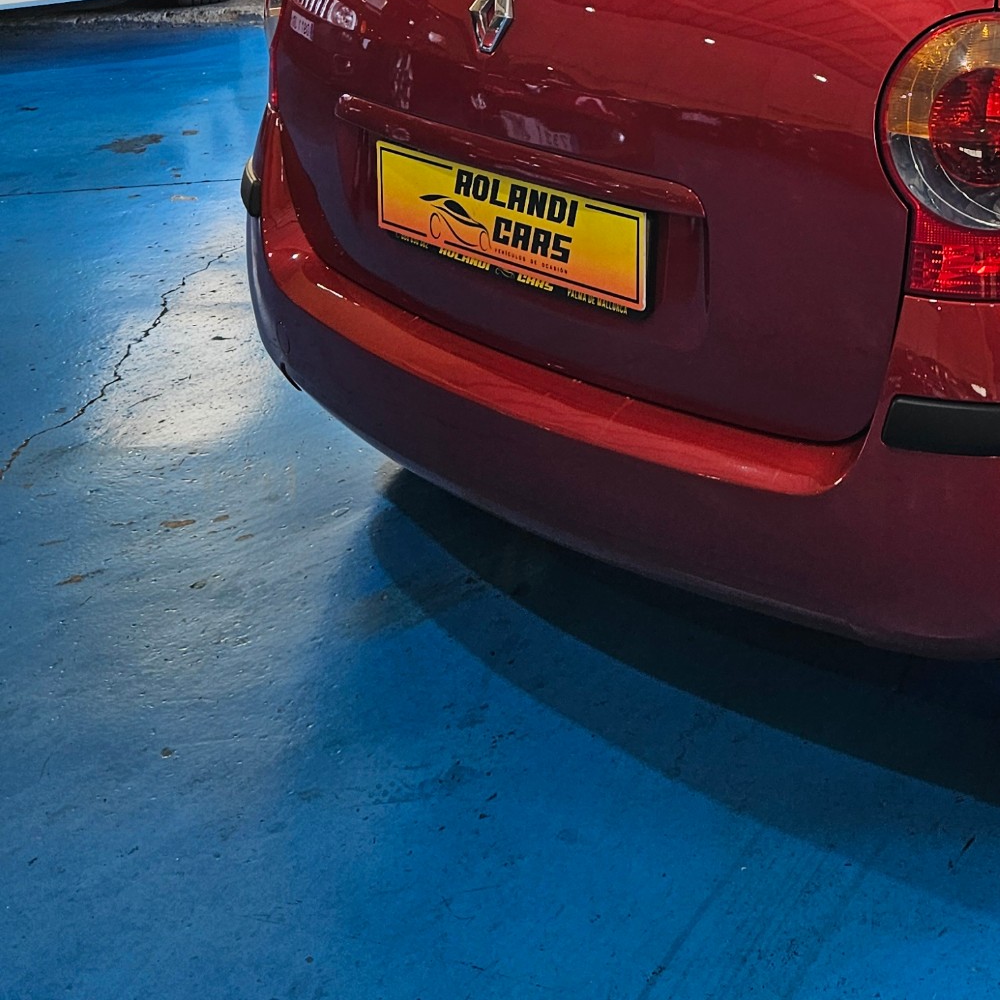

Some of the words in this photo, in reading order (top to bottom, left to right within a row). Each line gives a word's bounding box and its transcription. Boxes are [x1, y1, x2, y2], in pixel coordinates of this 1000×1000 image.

[455, 170, 579, 227] ROLANDI
[491, 216, 573, 264] CARS
[516, 273, 554, 293] CARS
